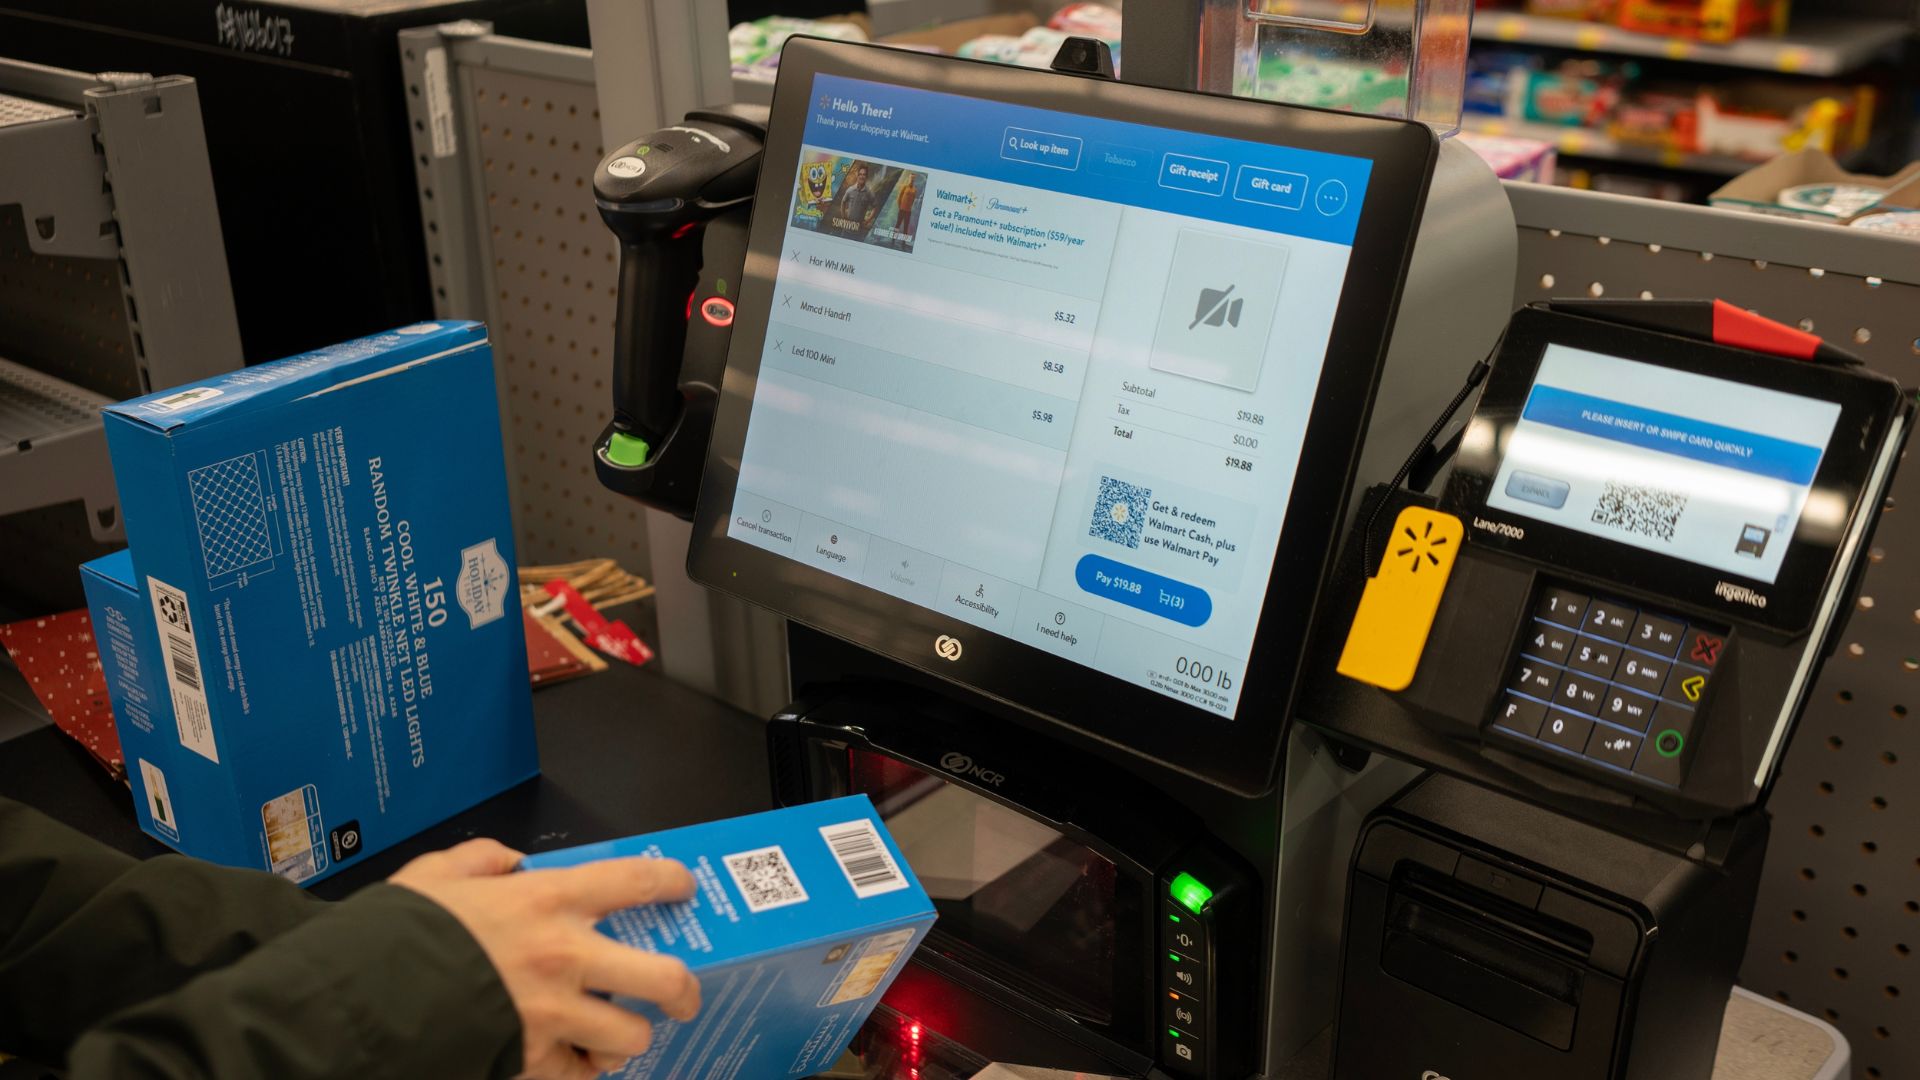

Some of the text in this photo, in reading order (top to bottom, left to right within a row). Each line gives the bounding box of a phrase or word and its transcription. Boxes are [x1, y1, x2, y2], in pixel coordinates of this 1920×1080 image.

[832, 98, 893, 119] Hello There!
[816, 114, 930, 143] Thank you for shopping at Walmart.
[1020, 138, 1069, 156] Look up item
[1104, 151, 1137, 168] Tobacco
[1169, 163, 1219, 183] Gift receipt
[1251, 176, 1292, 194] Gift card
[986, 197, 1029, 214] Paramount+
[831, 217, 860, 232] SURVIVOR
[930, 220, 954, 233] value!)
[955, 224, 987, 239] included
[987, 231, 1004, 243] with
[932, 207, 1085, 247] Get a Paramount+ subscription ($59/year
[809, 255, 823, 266] Hor
[839, 262, 856, 275] Milk
[800, 301, 823, 315] Mmcd
[1054, 310, 1075, 325] $5.32
[792, 345, 836, 366] Led 100 Mini
[1042, 360, 1064, 374] $8.58
[1122, 381, 1157, 399] Subtotal
[1032, 409, 1053, 424] $5.98
[1117, 403, 1130, 416] Tax
[1237, 409, 1264, 426] $19.88
[1113, 426, 1133, 440] Total
[1233, 434, 1258, 450] $0.00
[1581, 408, 1754, 459] PLEASE INSERT OR SWIPE CARD QUICKLY
[334, 425, 350, 486] VERY IMPORTANT!
[1225, 456, 1253, 472] $19.88
[1152, 501, 1216, 528] Get & redeem
[736, 516, 792, 543] Cancel transaction
[1148, 517, 1236, 553] Walmart Cash, plus
[1473, 516, 1524, 541] Lane/7000
[363, 527, 374, 561] BLANCO
[815, 545, 847, 563] Language
[1144, 535, 1220, 567] use Walmart Pay
[377, 575, 385, 592] RED
[468, 556, 484, 614] HOLIDAY
[889, 569, 916, 586] Volume
[1095, 571, 1142, 594] Pay $19.88
[380, 594, 387, 606] DE
[464, 575, 472, 604] TIME
[1170, 592, 1184, 609] (3)
[1715, 580, 1767, 609] ingenico
[368, 456, 425, 769] RANDOM TWINKLE NET LED LIGHTS
[373, 595, 382, 616] AZUL
[396, 519, 433, 699] COOL WHITE & BLUE
[422, 575, 448, 628] 150
[955, 593, 999, 619] Accessibility
[1550, 597, 1558, 612] 1
[1594, 610, 1605, 625] 2
[1610, 617, 1624, 628] ABC
[1641, 624, 1653, 639] 3
[1659, 632, 1672, 644] DEF
[384, 623, 394, 649] LUCES
[1041, 624, 1059, 640] need
[1060, 629, 1077, 646] help
[377, 619, 392, 682] PARPADEANTES
[388, 651, 396, 667] LED
[1535, 633, 1545, 648] 4
[1579, 646, 1591, 661] 5
[1626, 660, 1637, 675] 6
[1641, 667, 1658, 679] MNO
[1176, 656, 1232, 690] 0.00 lb
[386, 683, 394, 694] AL
[1520, 668, 1532, 682] 7
[1566, 683, 1578, 698] 8
[1582, 690, 1595, 701] TUV
[1612, 696, 1623, 712] 9
[388, 696, 397, 718] AZAR
[1505, 703, 1564, 734] F 0
[968, 764, 1006, 787] NCR
